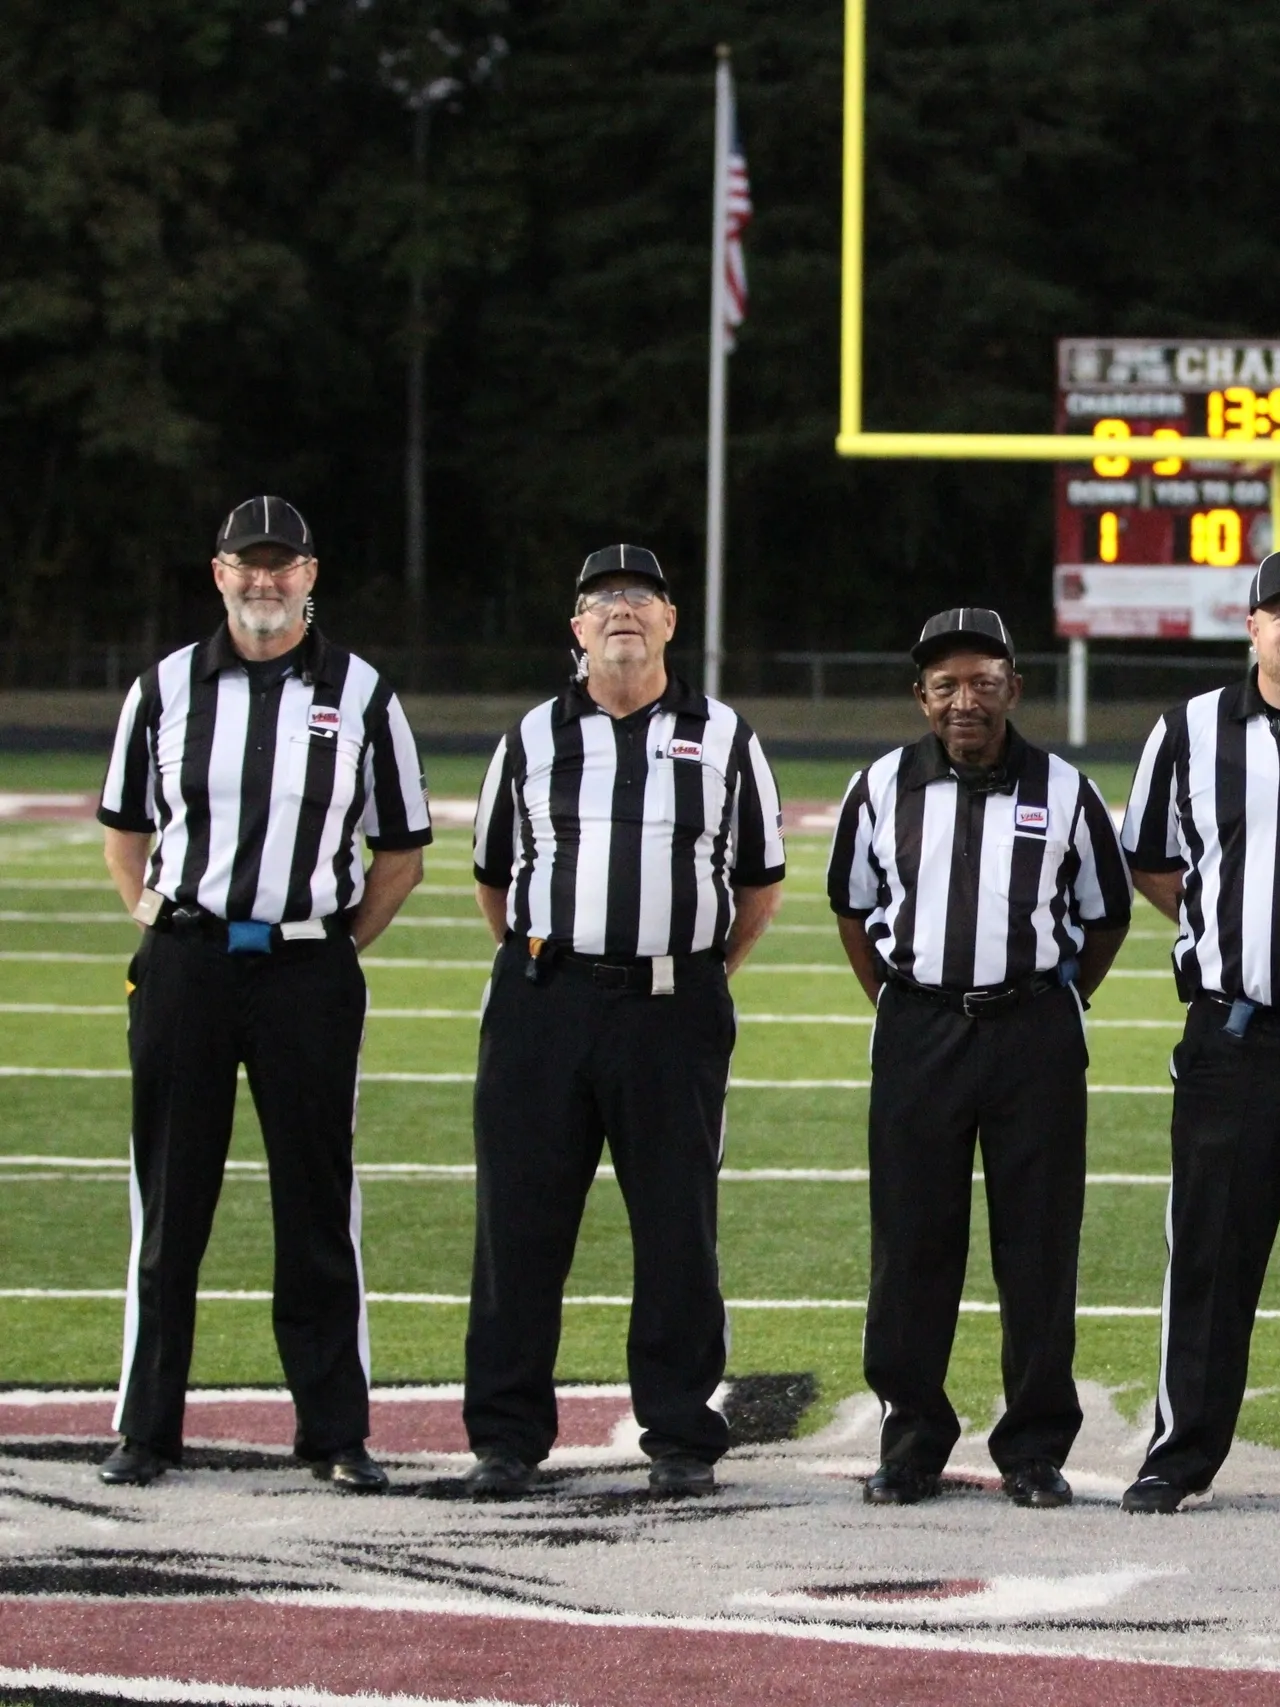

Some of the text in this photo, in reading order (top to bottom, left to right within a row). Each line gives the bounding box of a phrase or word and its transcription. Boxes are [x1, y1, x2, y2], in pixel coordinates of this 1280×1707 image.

[1066, 393, 1185, 416] CHARGERS
[1067, 481, 1138, 505] DOWN
[1202, 481, 1230, 505] TO
[1232, 481, 1268, 505] GO
[1099, 511, 1119, 563] 1
[1190, 508, 1241, 567] 10
[312, 711, 339, 723] VHSL
[672, 746, 700, 757] VHSL
[1020, 811, 1044, 822] VHSL
